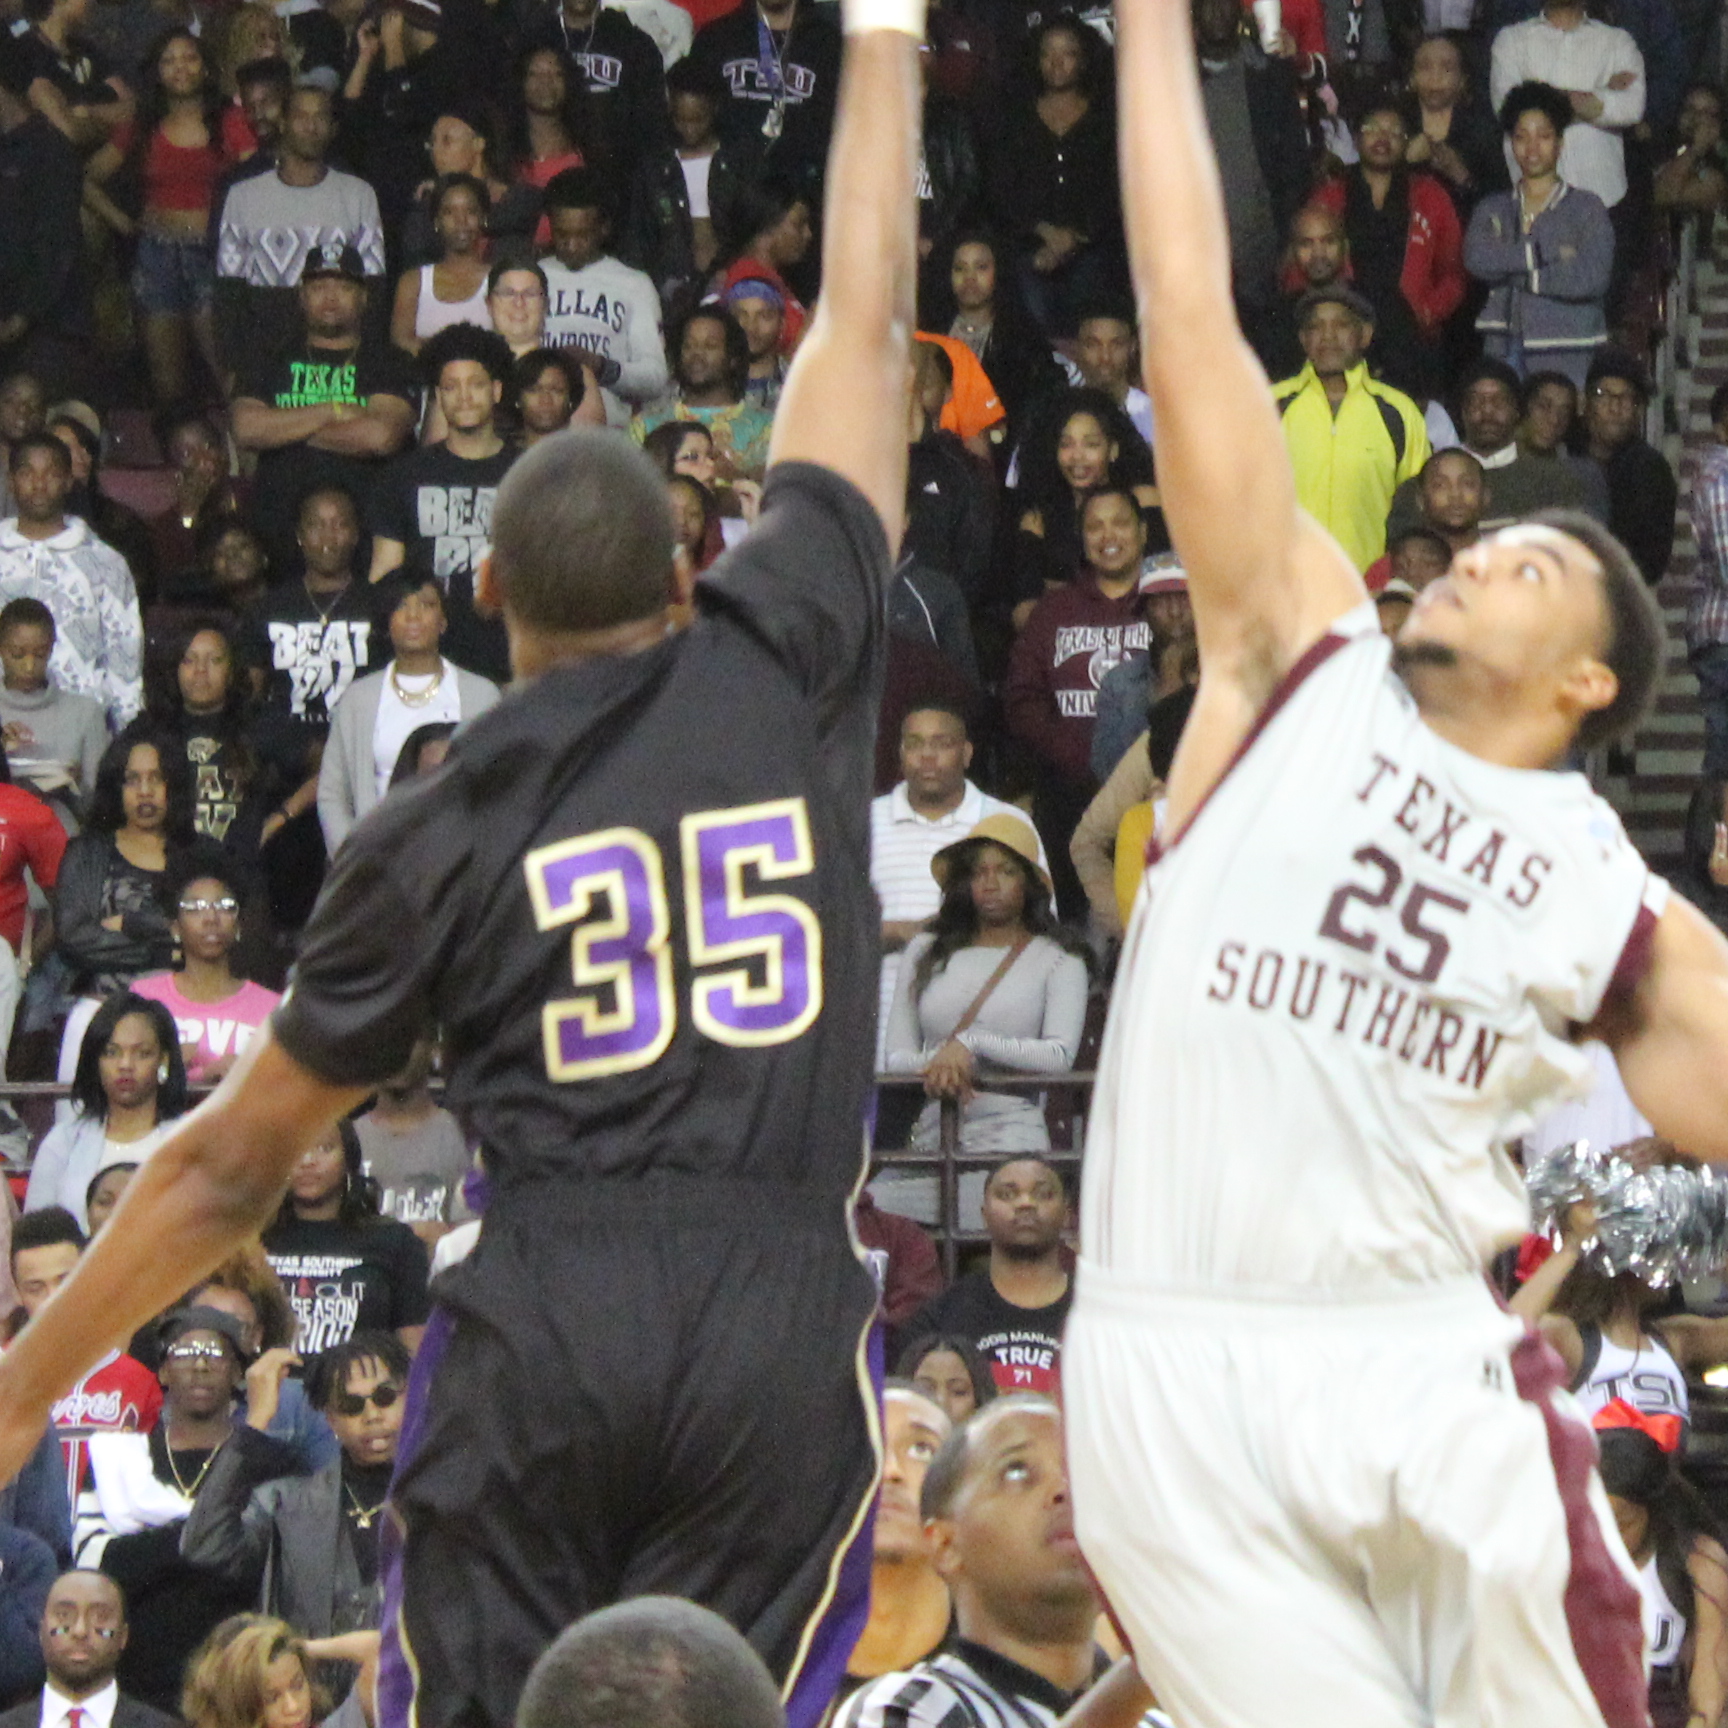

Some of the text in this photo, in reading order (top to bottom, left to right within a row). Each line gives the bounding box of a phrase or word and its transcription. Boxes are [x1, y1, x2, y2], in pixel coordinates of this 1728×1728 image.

[548, 290, 627, 335] LLAS
[290, 363, 358, 396] TEXAS
[267, 620, 372, 671] BEAT
[1348, 752, 1555, 912] TEXAS
[1317, 842, 1472, 986] 25
[522, 795, 825, 1086] 35
[1206, 941, 1506, 1092] SOUTHERN
[290, 1298, 359, 1325] SEASON
[995, 1348, 1054, 1371] TRUE
